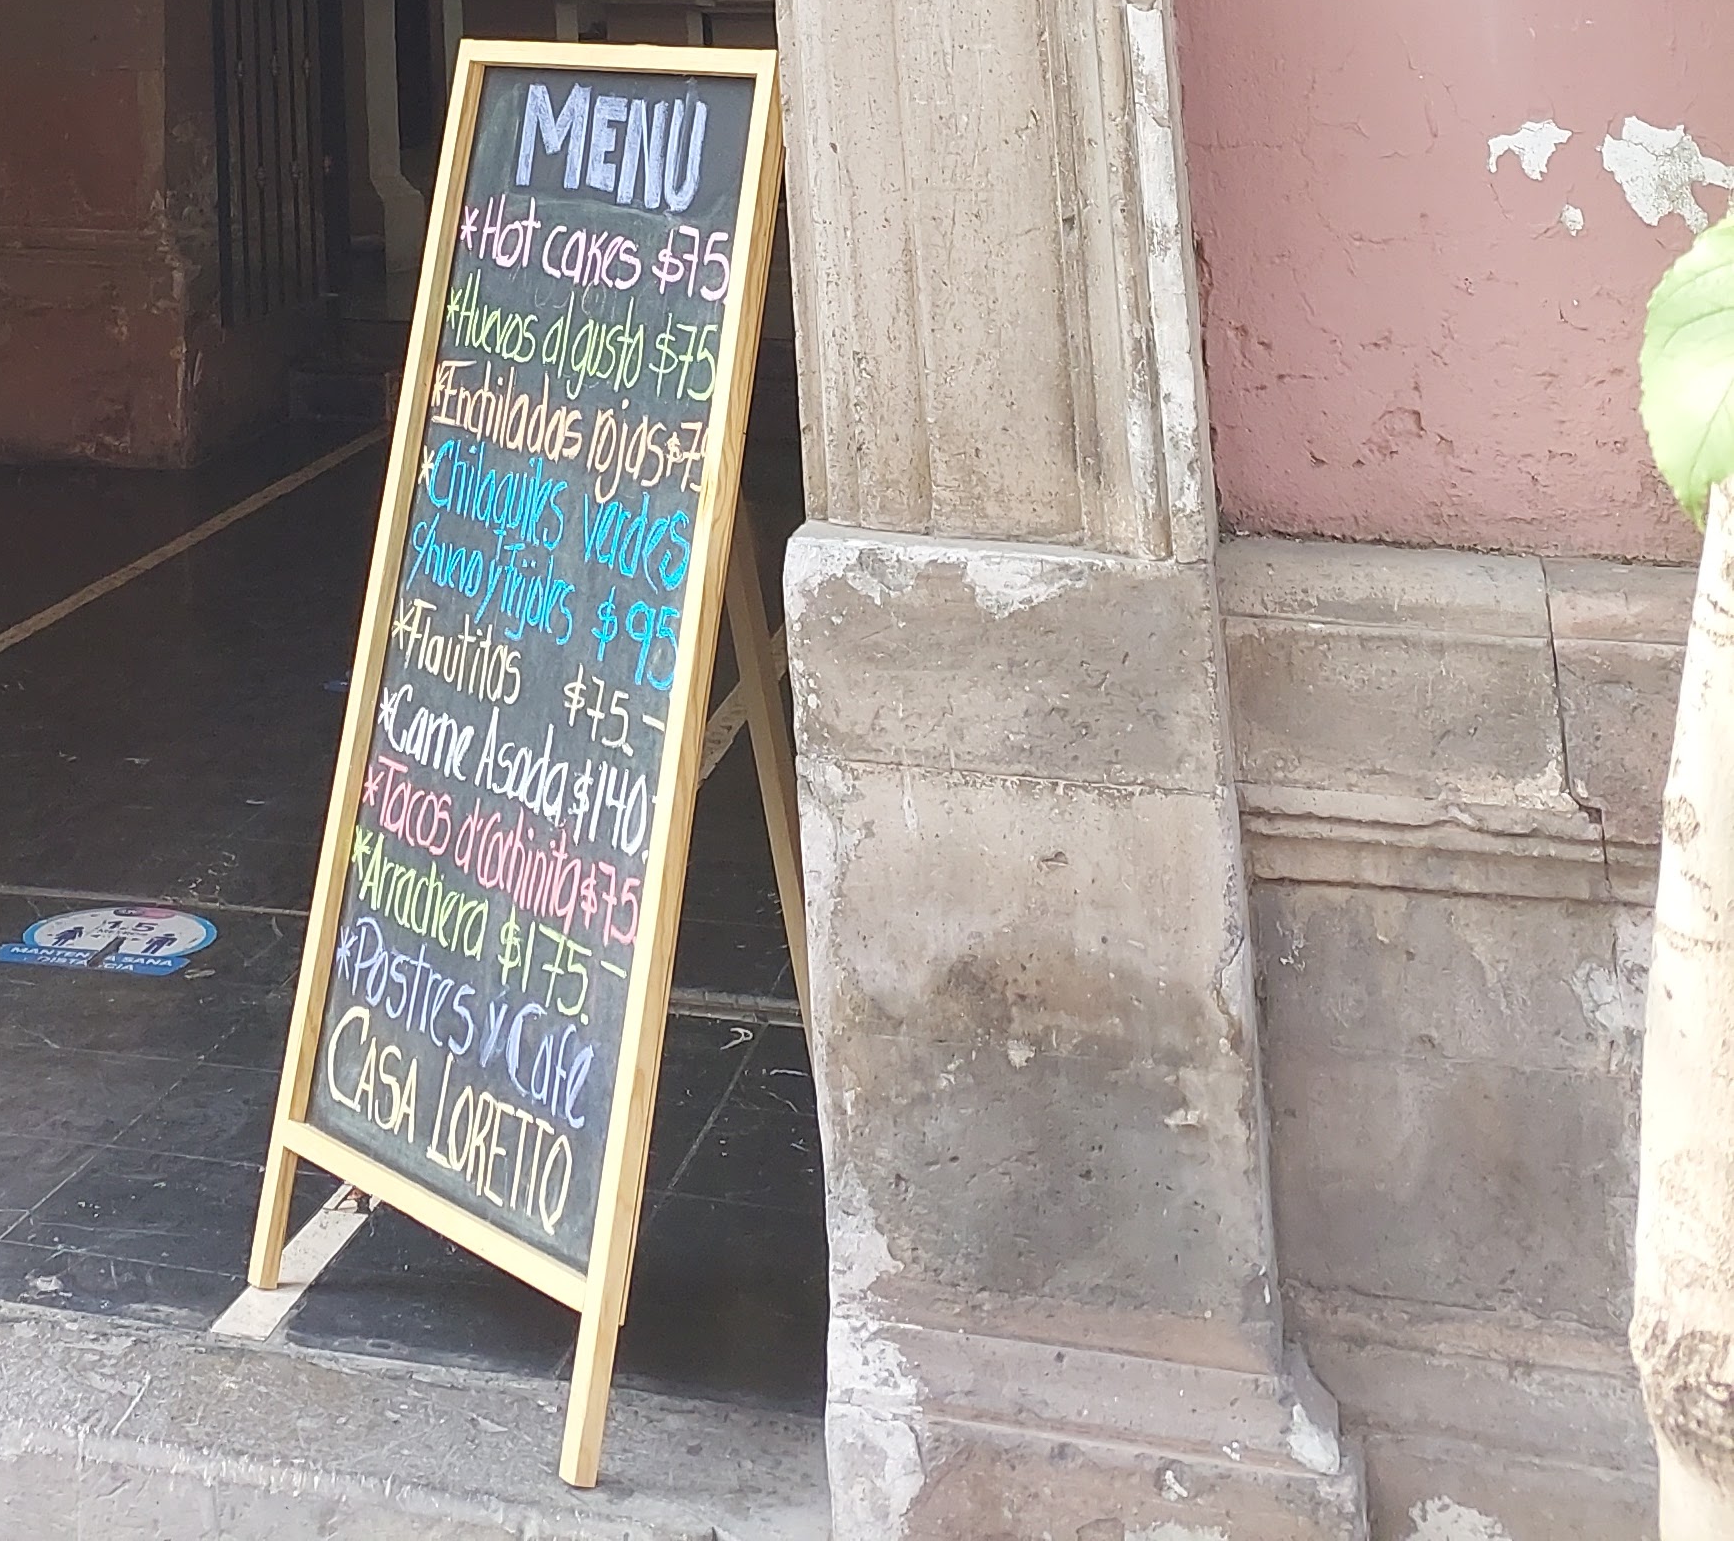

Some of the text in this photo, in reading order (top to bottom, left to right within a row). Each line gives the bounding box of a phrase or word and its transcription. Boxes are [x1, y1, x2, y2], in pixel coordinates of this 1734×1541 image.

[516, 82, 708, 213] MENU
[479, 194, 541, 268] Hot
[455, 269, 719, 401] Huevos al gusto $75
[432, 360, 582, 463] Enchiladas
[378, 756, 452, 856] Tacos
[387, 683, 475, 781] Carne
[475, 705, 570, 826] Asada
[359, 833, 490, 961] Arrachera
[37, 956, 134, 971] DISTACIA
[352, 916, 475, 1056] Postres
[327, 1006, 573, 1236] CASA LORETTO
